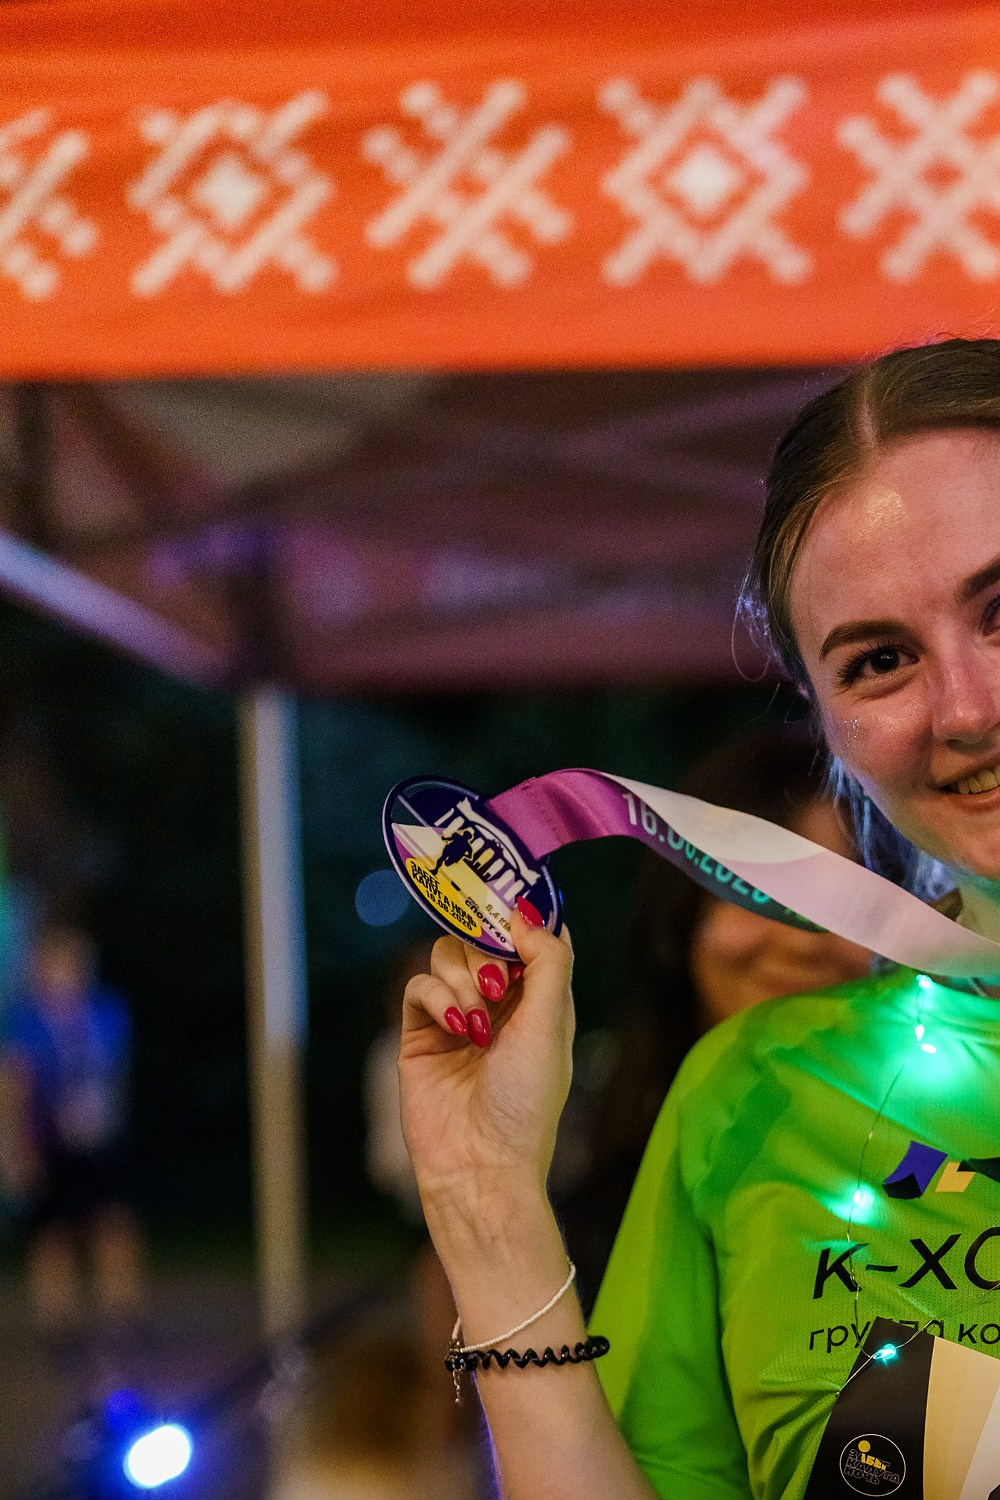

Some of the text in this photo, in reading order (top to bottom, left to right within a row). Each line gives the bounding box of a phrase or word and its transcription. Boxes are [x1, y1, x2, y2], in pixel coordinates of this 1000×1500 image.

[410, 860, 440, 886] ЗАБЕГ
[451, 901, 477, 928] НОЧЬ
[465, 900, 507, 943] СПОРТ 40
[809, 1318, 945, 1354] груа
[847, 1458, 900, 1484] КАЛУГА
[848, 1449, 891, 1471] ЗАБЕГ
[844, 1465, 880, 1485] НОЧЬ
